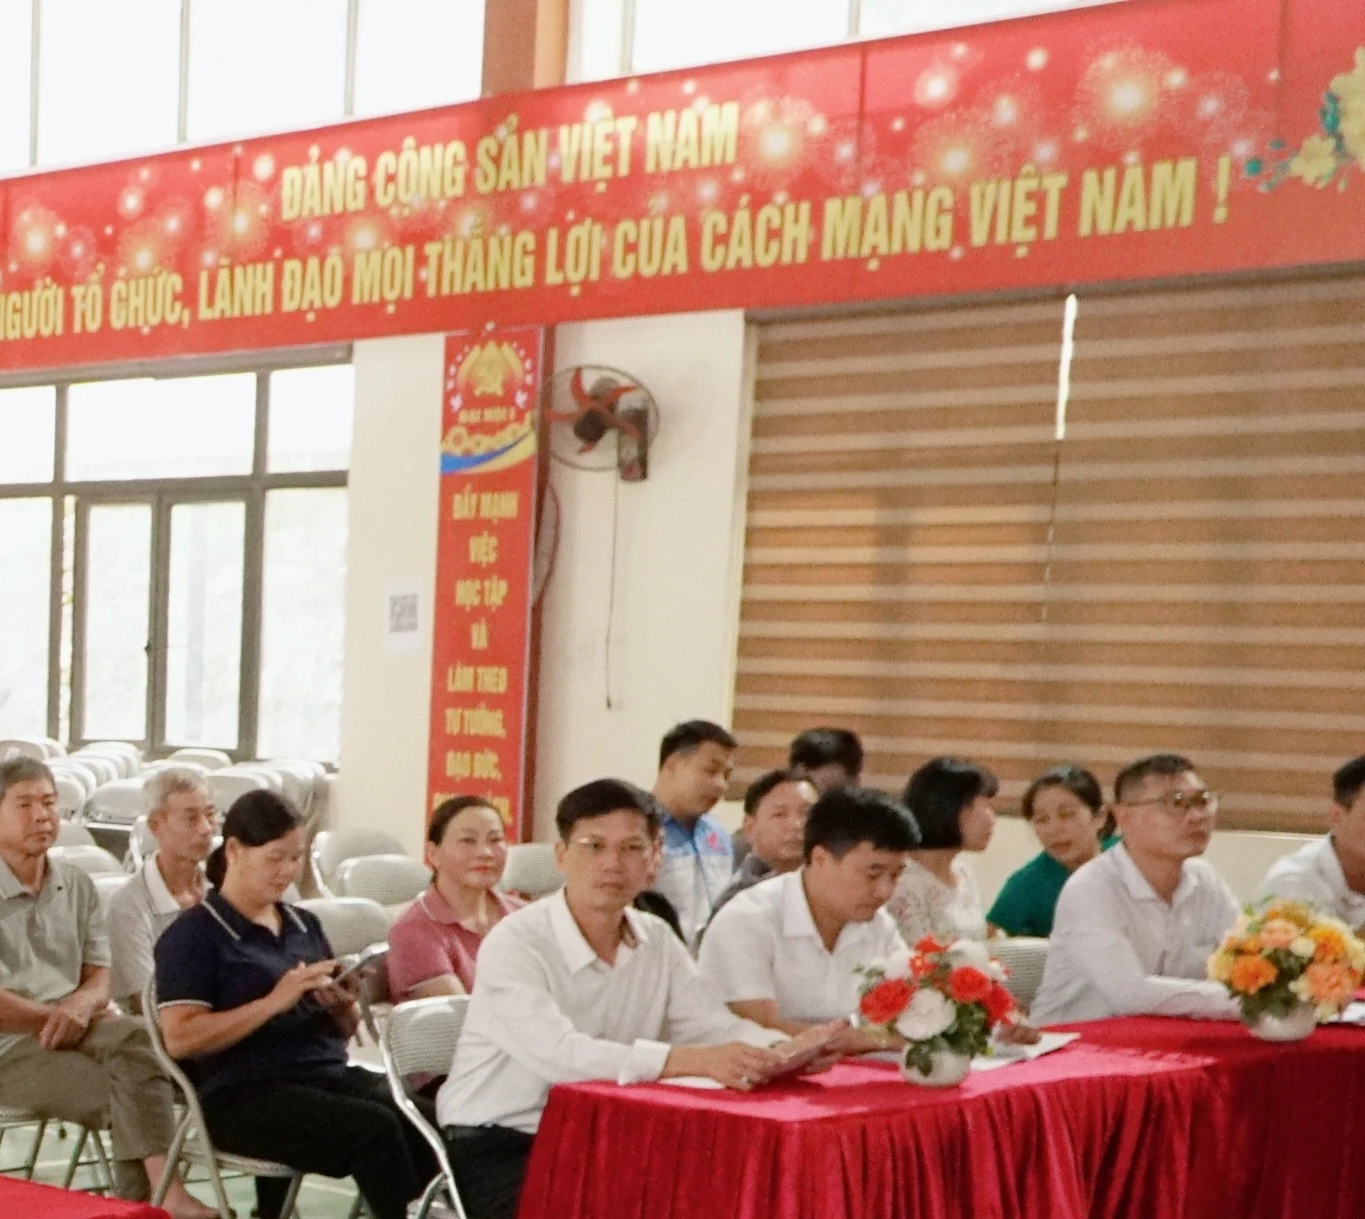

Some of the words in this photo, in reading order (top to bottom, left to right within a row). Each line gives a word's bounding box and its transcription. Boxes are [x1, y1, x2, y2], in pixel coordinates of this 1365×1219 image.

[281, 144, 368, 222] ĐẢNG
[374, 136, 467, 217] CỘNG
[475, 113, 549, 195] SẢN
[559, 101, 639, 194] VIỆT
[645, 101, 740, 174] NAM
[71, 262, 105, 334] TỔ
[110, 265, 191, 330] CHỨC,
[198, 257, 275, 321] LÃNH
[281, 255, 344, 322] ĐẠO
[352, 244, 416, 314] MỌI
[424, 212, 536, 298] THẮNG
[545, 216, 604, 297] LỢI
[701, 193, 812, 273] CÁCH
[821, 186, 955, 271] MẠNG
[970, 162, 1068, 258] VIỆT
[1078, 157, 1197, 238] NAM
[1213, 155, 1231, 224] !
